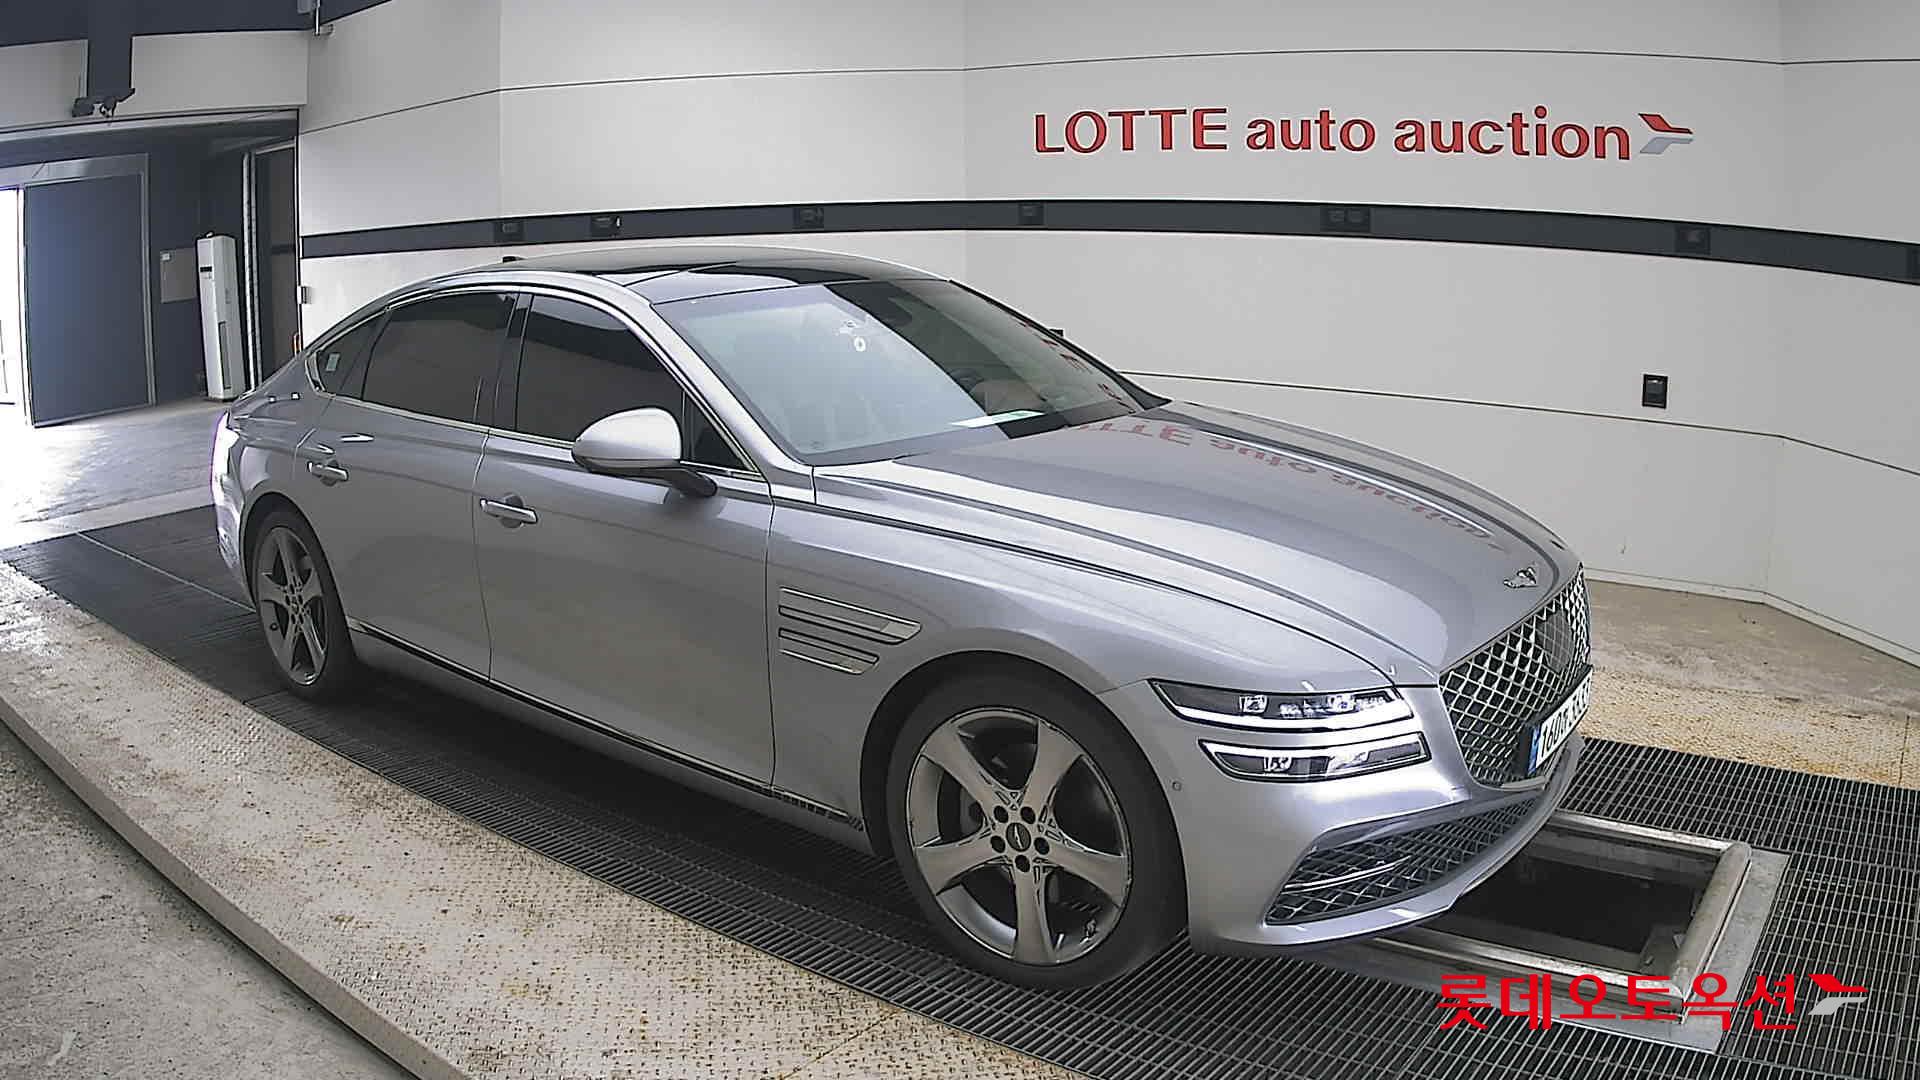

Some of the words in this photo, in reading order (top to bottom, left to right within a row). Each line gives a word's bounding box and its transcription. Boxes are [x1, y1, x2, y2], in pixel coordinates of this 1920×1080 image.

[1035, 108, 1228, 153] LOTTE
[1246, 109, 1377, 151] auto
[1393, 105, 1631, 160] auction
